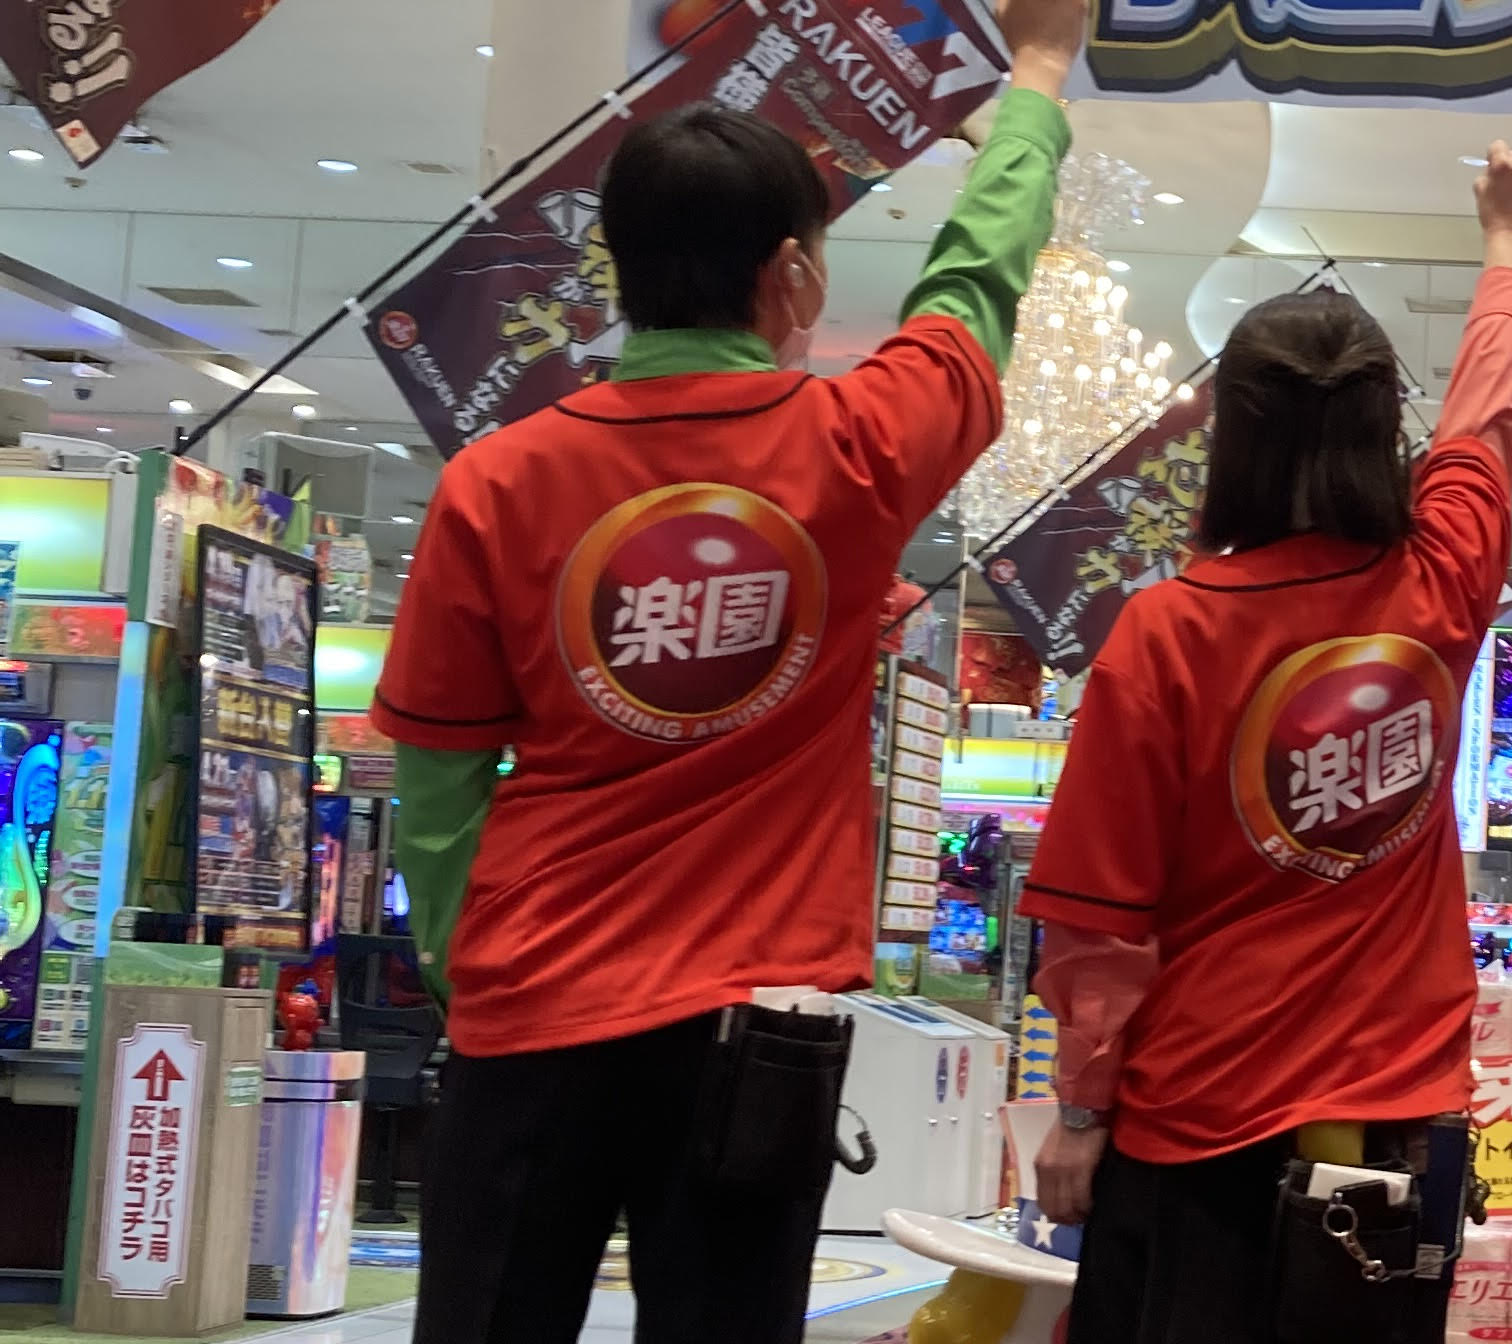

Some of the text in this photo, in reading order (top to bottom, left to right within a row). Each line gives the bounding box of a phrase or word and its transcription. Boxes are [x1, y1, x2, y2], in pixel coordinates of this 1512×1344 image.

[576, 632, 815, 739] EXCITING AMUSEMENT
[608, 570, 790, 667] 楽園
[1289, 698, 1434, 833] 楽園
[119, 1104, 156, 1262] 灰皿はコチラ
[147, 1106, 182, 1263] 加熱式タバコ用
